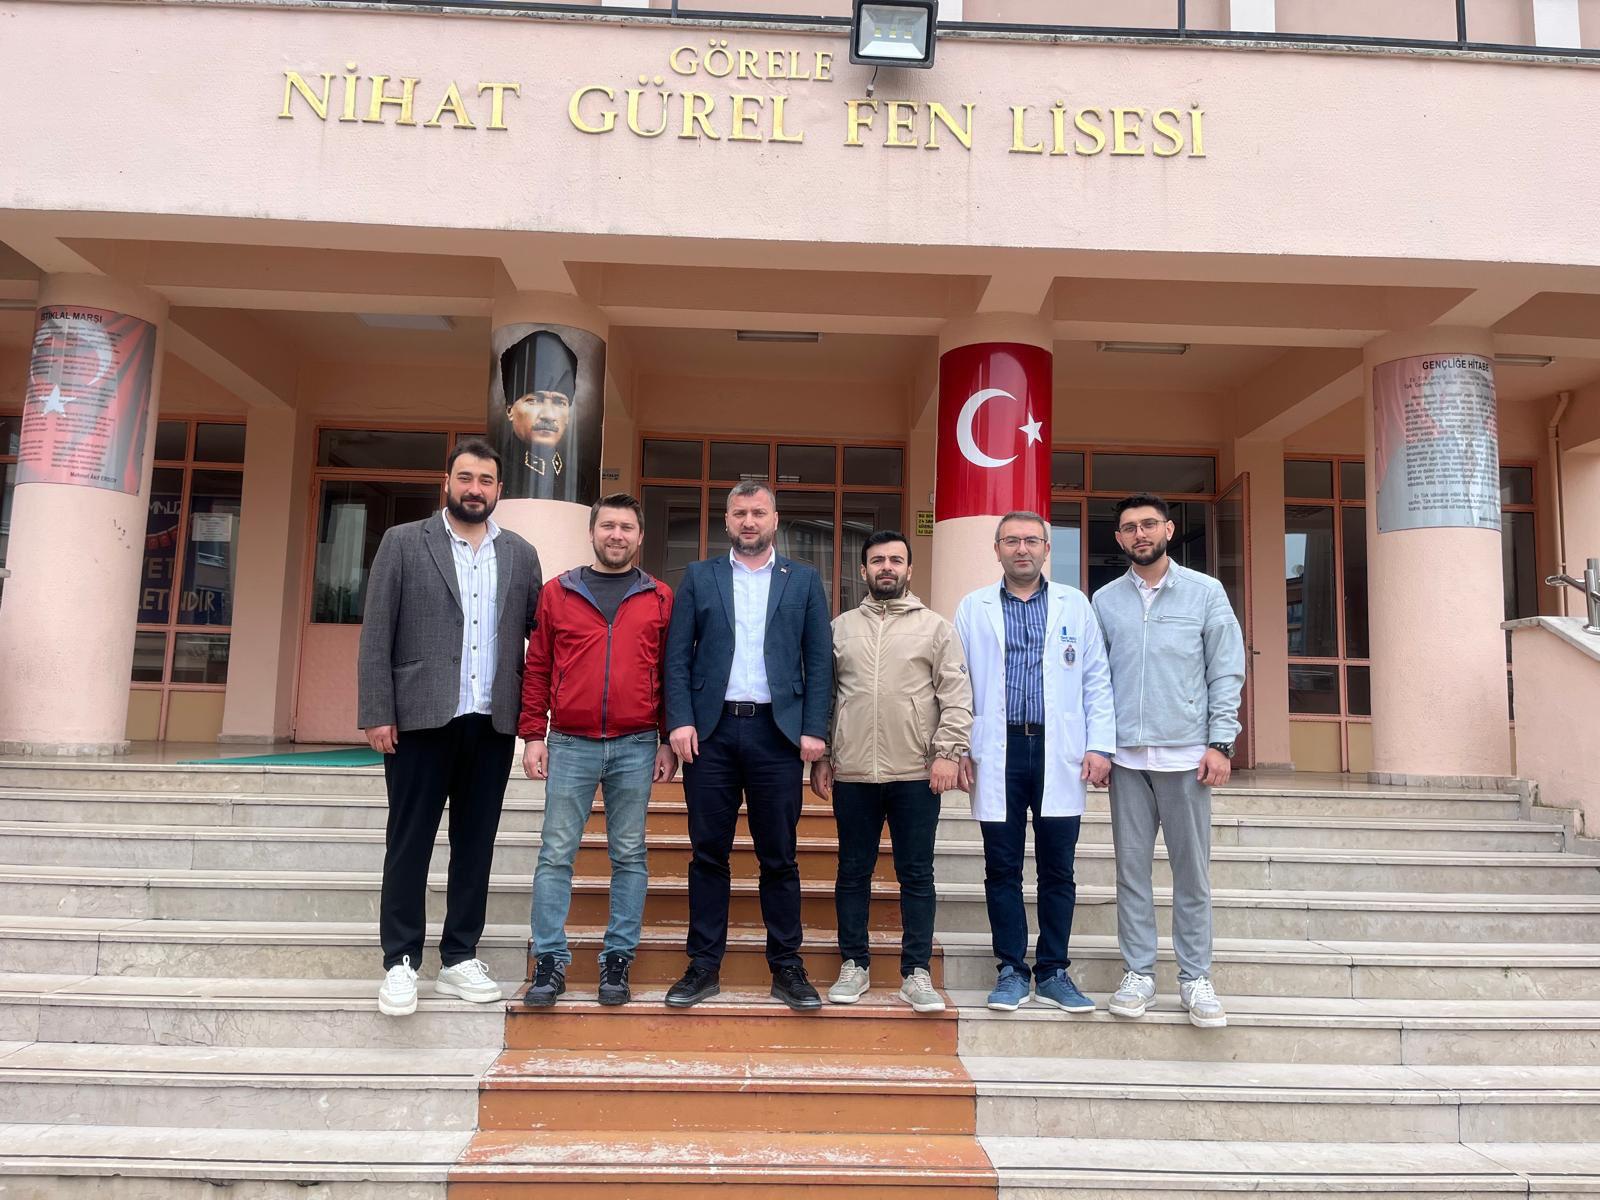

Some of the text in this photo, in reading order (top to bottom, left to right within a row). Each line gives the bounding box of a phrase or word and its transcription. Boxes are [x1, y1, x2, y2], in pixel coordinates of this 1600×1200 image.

[669, 39, 834, 83] GÖRELE
[278, 61, 1207, 159] NİHAT GÜREL FEN LİSESİ
[1422, 357, 1467, 371] GENÇLİĞE
